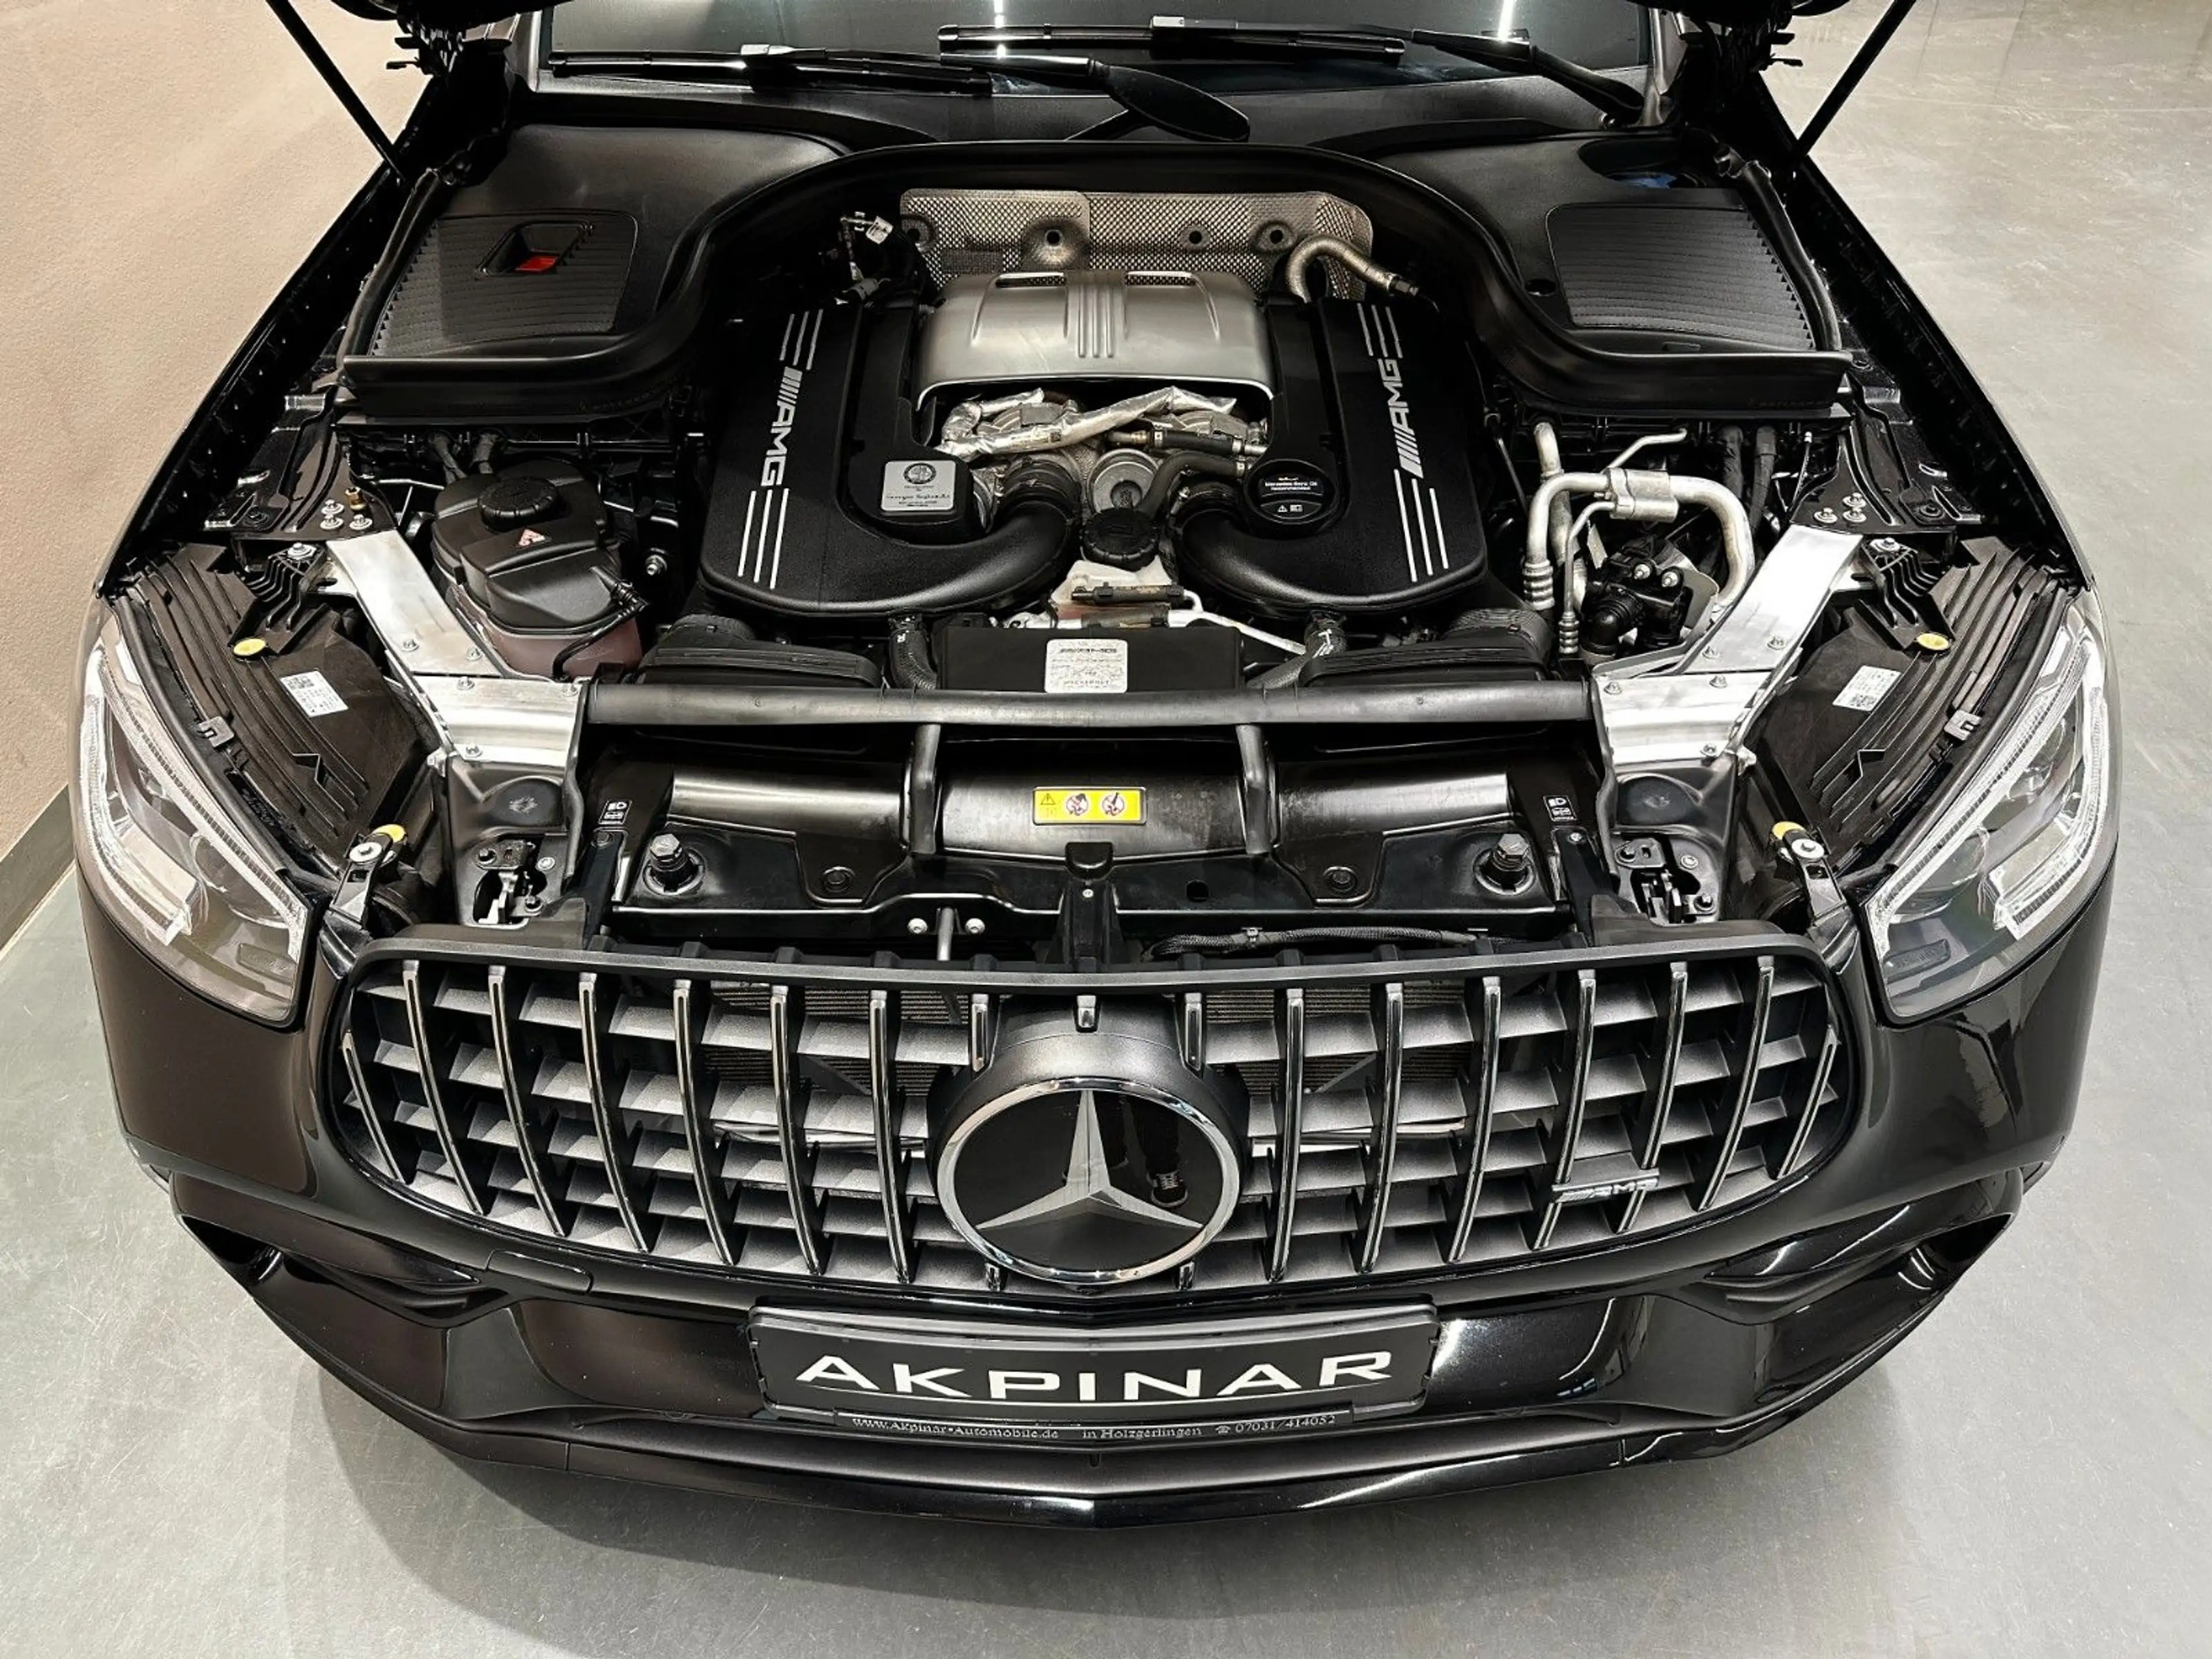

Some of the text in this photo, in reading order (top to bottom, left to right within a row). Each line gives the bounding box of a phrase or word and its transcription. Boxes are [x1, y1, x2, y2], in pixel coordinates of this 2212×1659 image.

[1377, 358, 1415, 435] AMG
[760, 400, 796, 487] AMG
[796, 1351, 1392, 1401] AKPINAR
[1082, 1429, 1097, 1438] in
[1100, 1427, 1202, 1440] Holzgerlingen
[1235, 1414, 1336, 1433] 07031/414052
